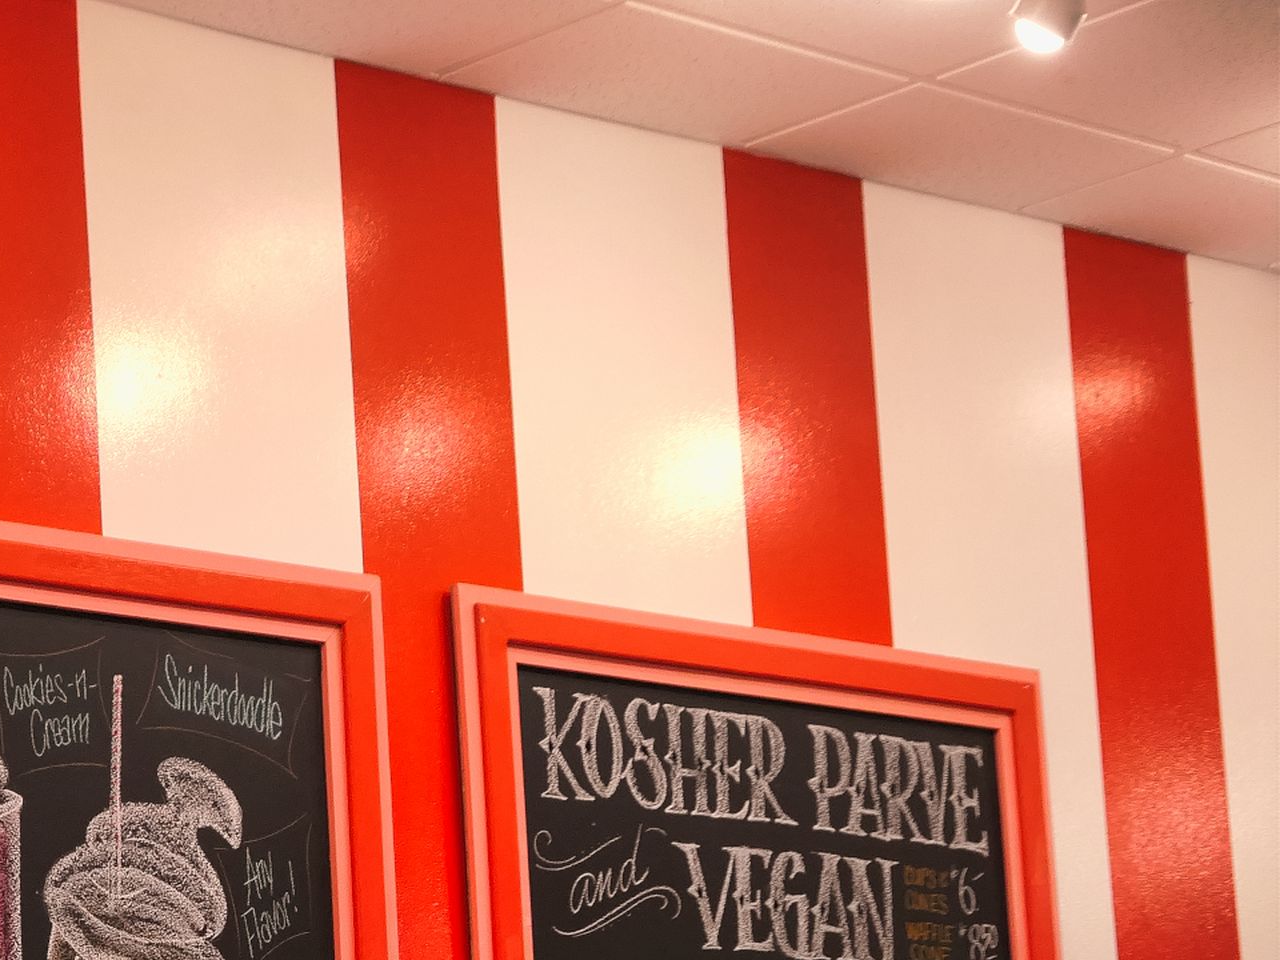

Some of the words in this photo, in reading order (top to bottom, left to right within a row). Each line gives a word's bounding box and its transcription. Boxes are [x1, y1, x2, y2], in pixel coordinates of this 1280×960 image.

[30, 710, 90, 758] Cream
[158, 653, 283, 740] Snickerdoodle
[532, 686, 799, 826] KOSHER
[807, 723, 990, 857] PARVE
[241, 860, 299, 959] Flavor!
[243, 846, 274, 906] Any
[570, 823, 650, 914] and
